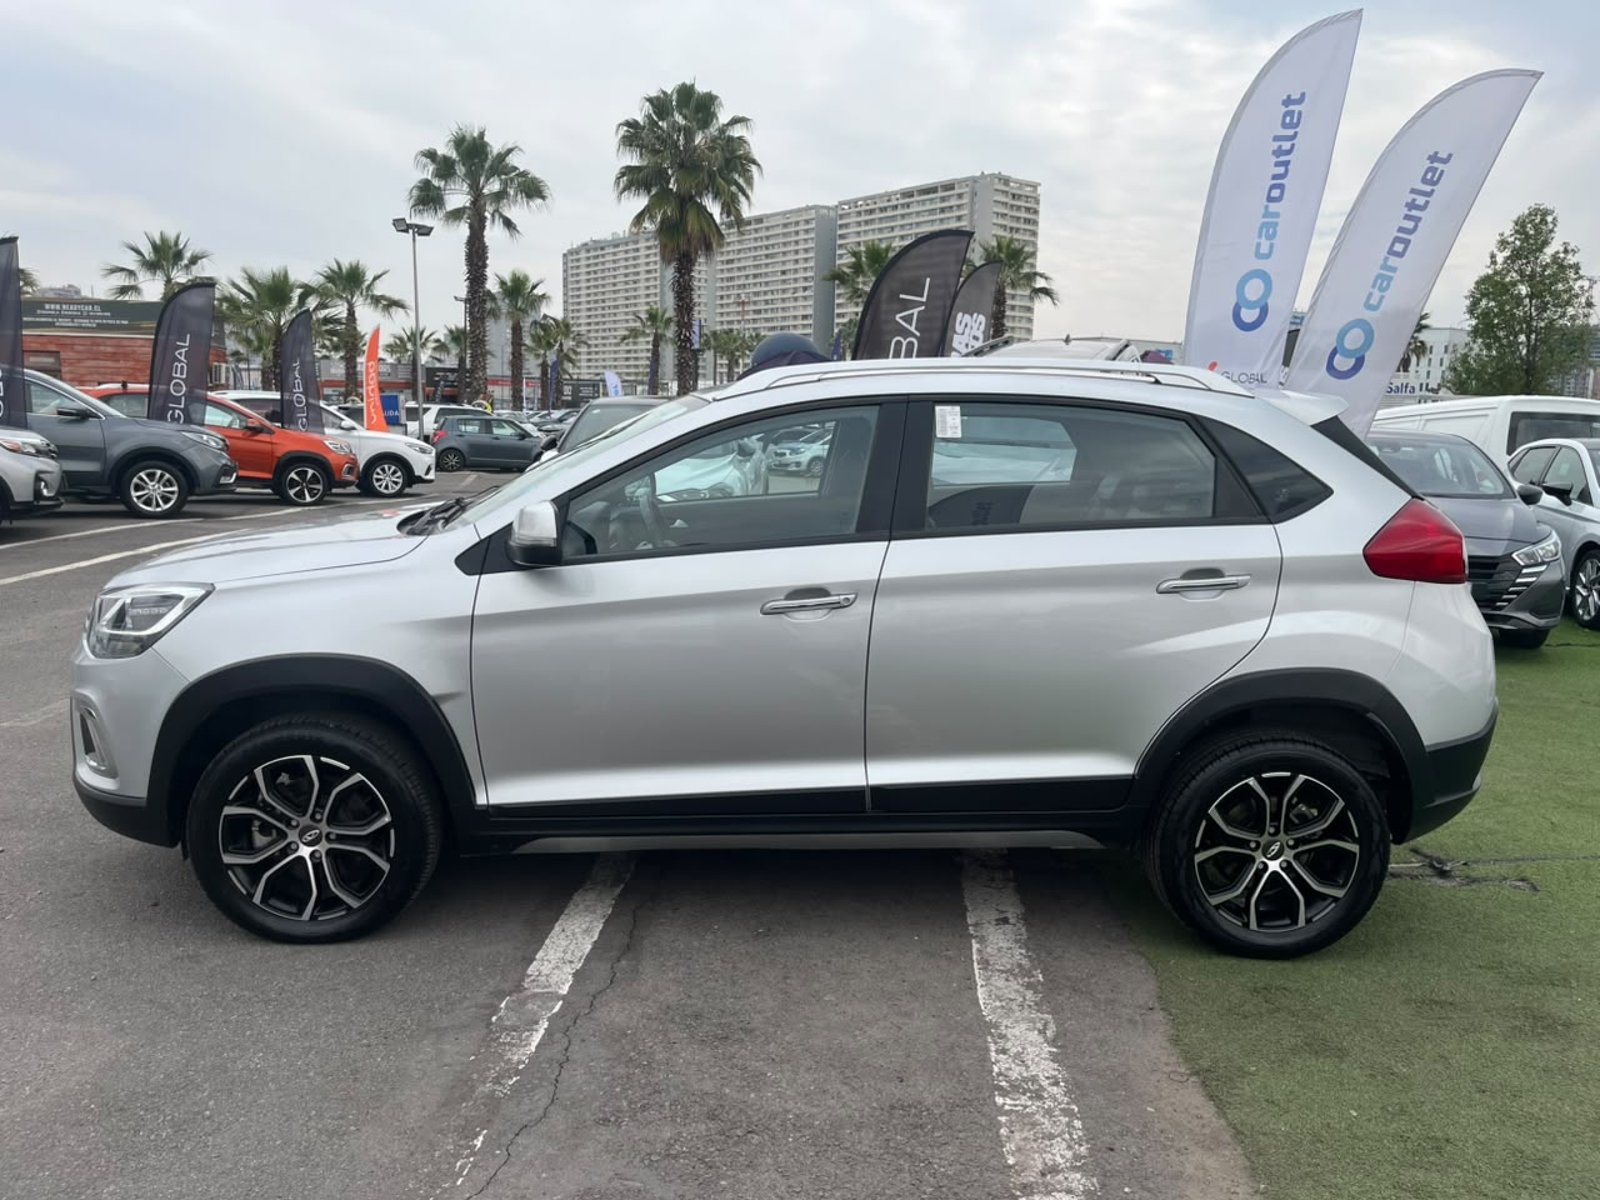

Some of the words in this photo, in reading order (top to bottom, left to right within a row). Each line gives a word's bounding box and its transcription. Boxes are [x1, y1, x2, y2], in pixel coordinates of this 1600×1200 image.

[1254, 91, 1306, 261] caroutlet
[1363, 150, 1453, 313] caroutlet
[167, 333, 190, 424] GLOBAL
[292, 358, 308, 431] GLOBAL
[1386, 382, 1416, 394] Salfa
